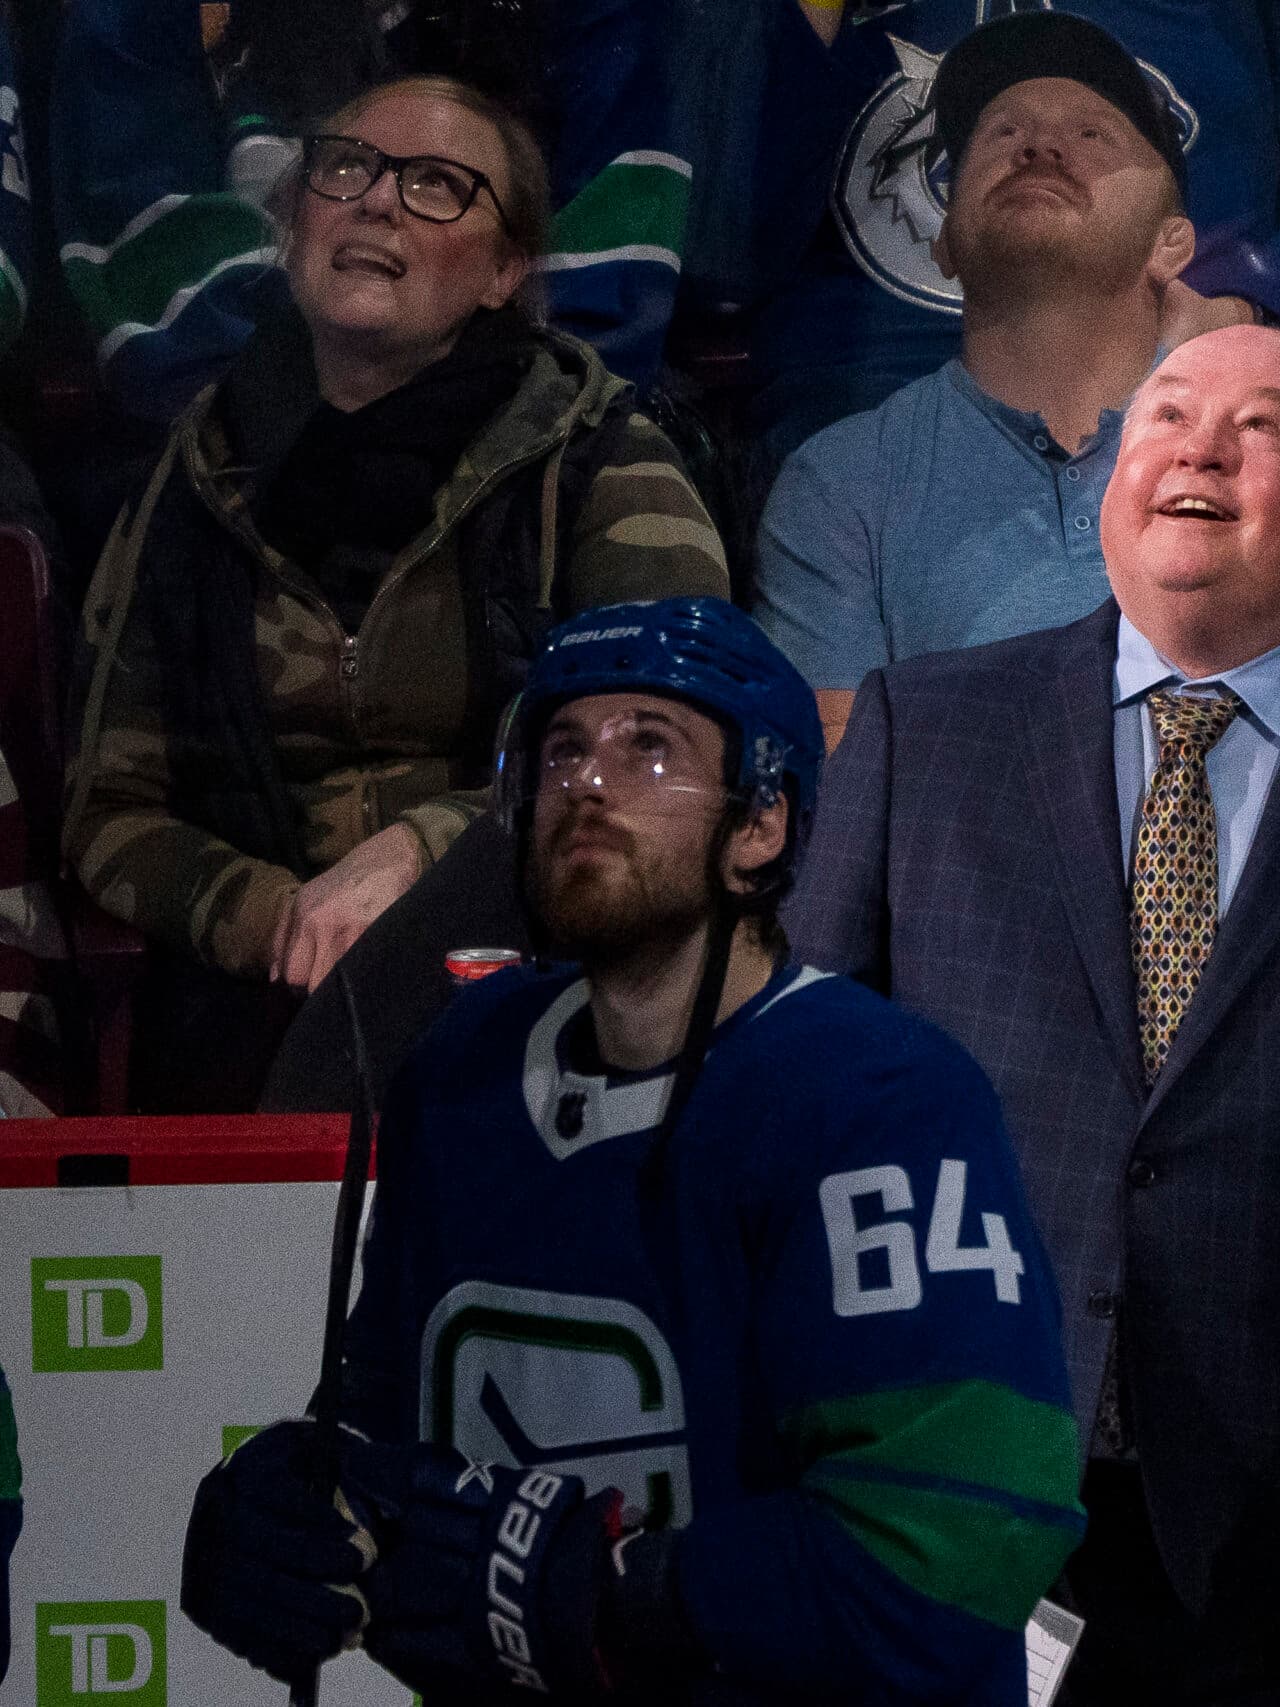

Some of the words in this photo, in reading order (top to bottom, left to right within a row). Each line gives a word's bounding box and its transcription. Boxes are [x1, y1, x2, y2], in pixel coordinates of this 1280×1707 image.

[818, 1157, 1025, 1318] 64
[44, 1278, 149, 1349] TD
[49, 1623, 154, 1694] TD
